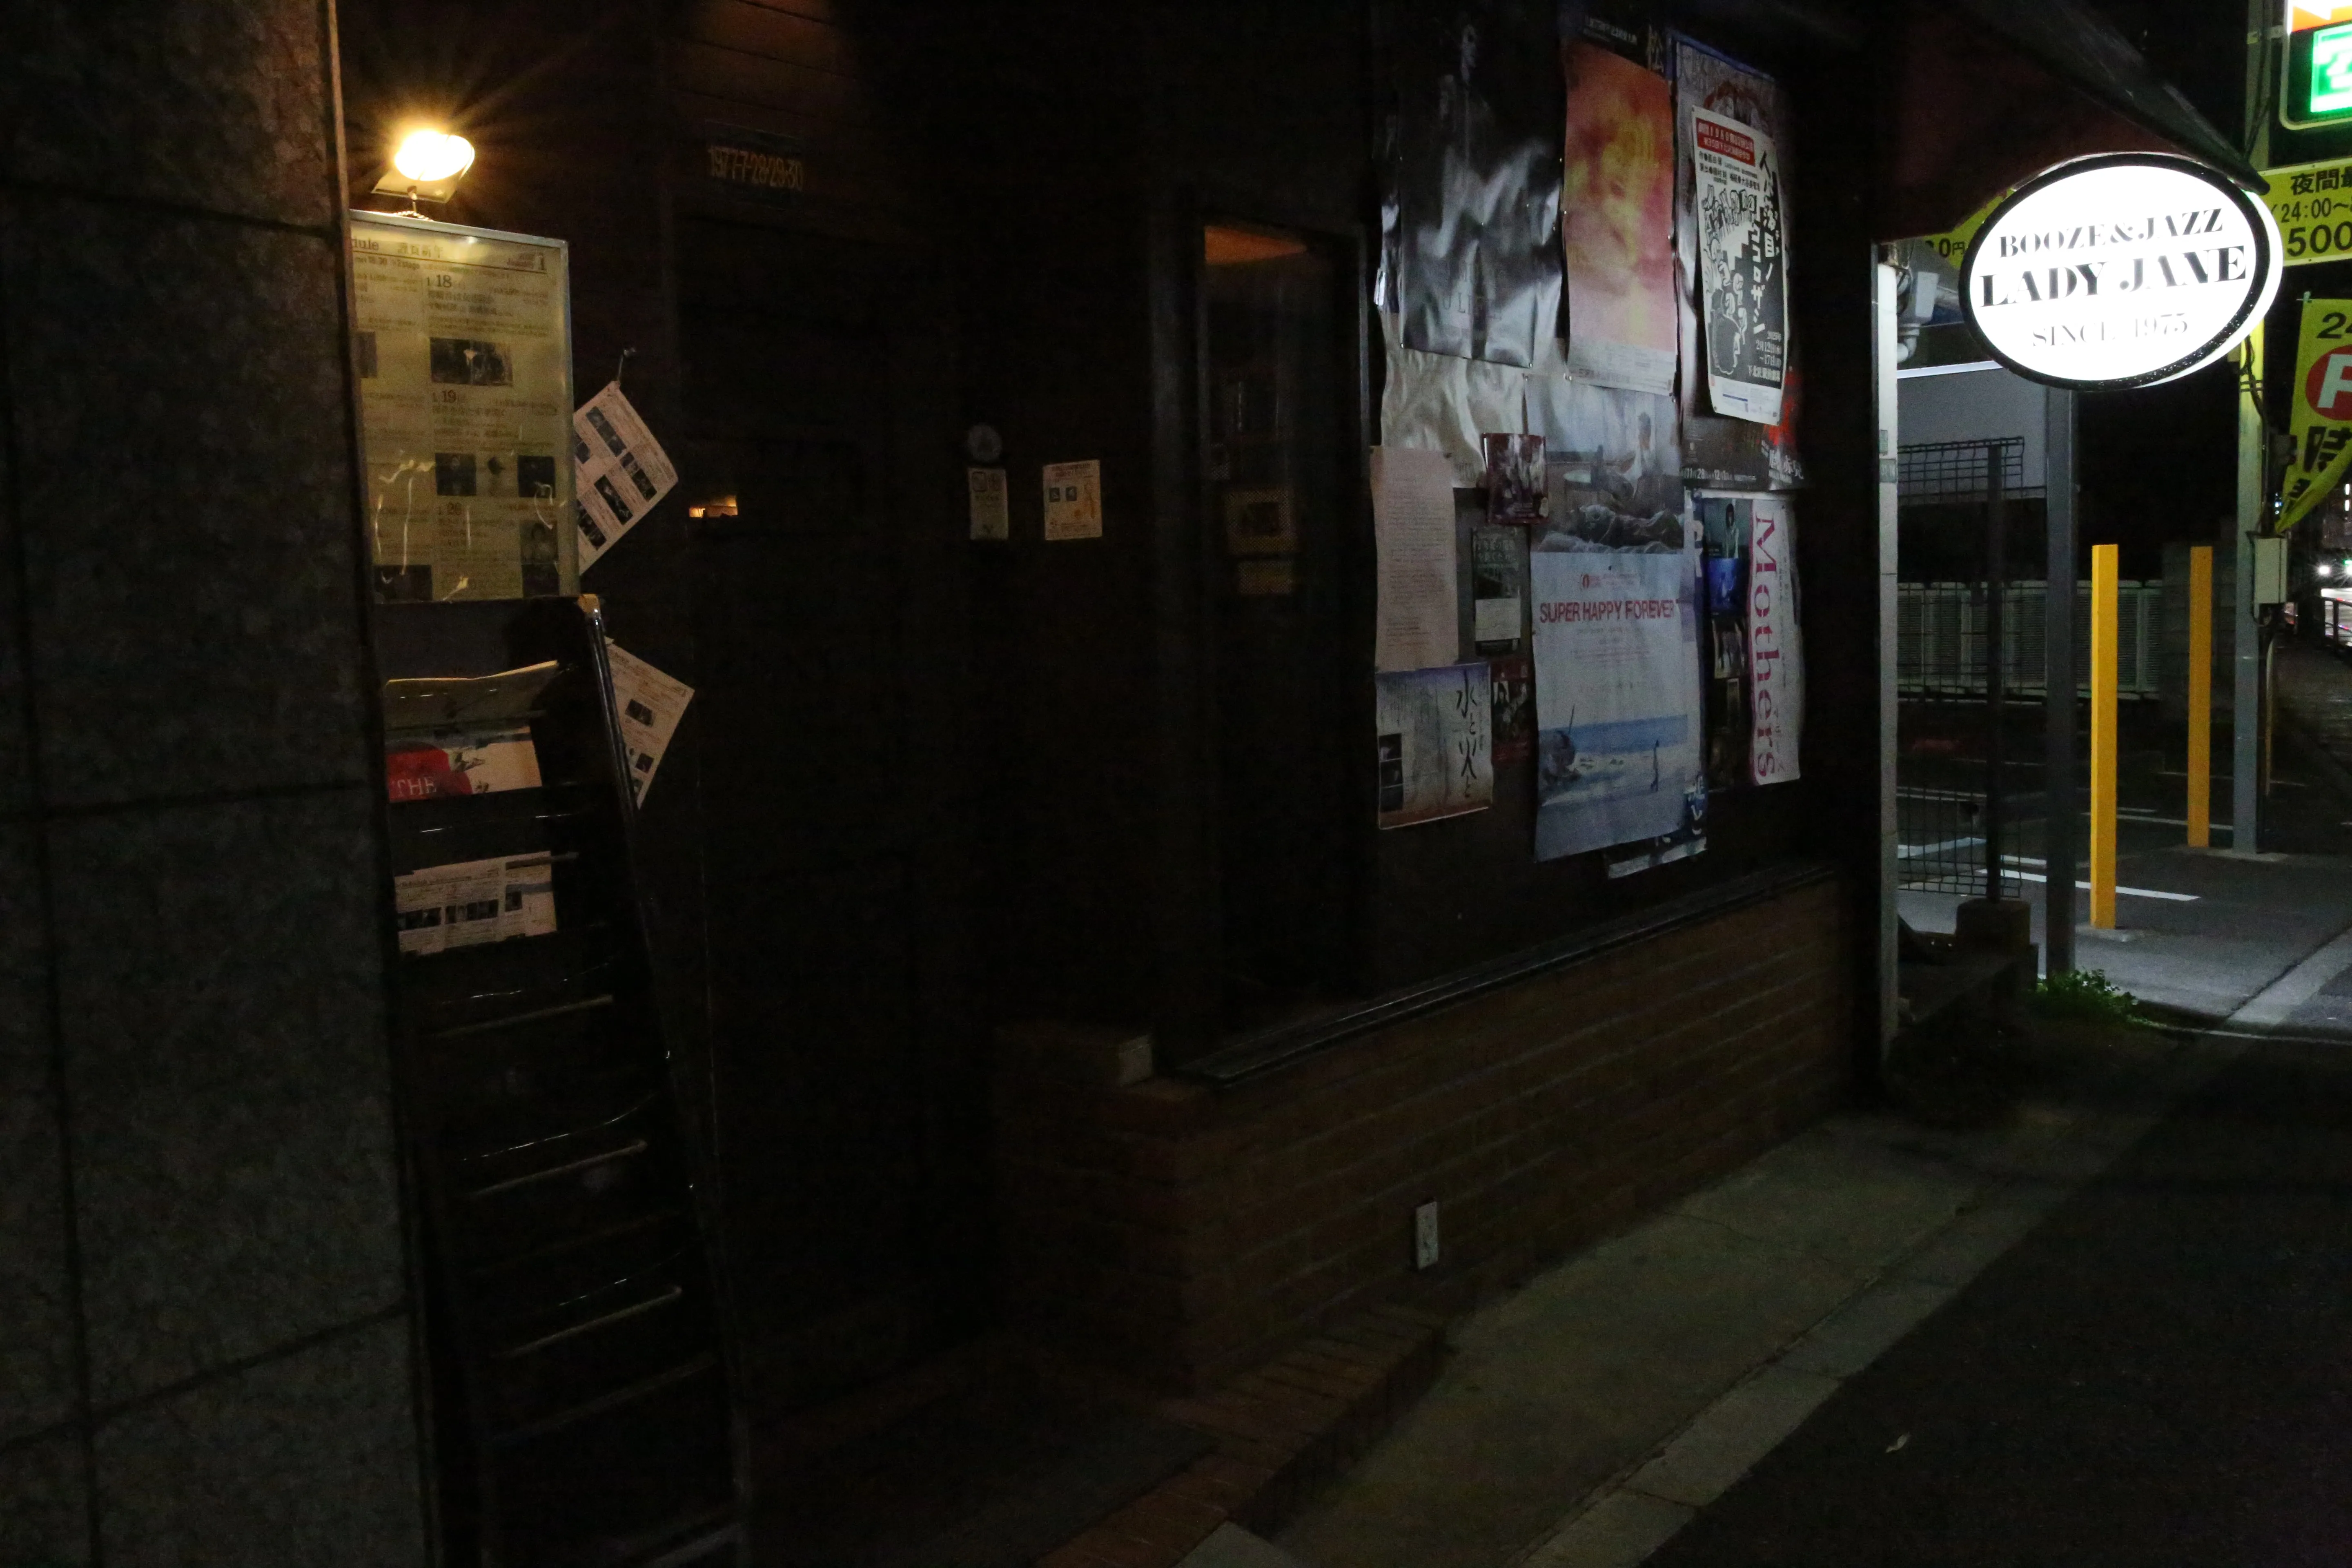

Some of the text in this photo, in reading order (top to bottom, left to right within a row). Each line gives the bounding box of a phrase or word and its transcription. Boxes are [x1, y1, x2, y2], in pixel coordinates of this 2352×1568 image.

[1999, 208, 2223, 258] BOOZE&JAZZ
[436, 274, 452, 287] 18
[1980, 245, 2247, 307] LADY JANE
[2033, 313, 2188, 347] SINCE 1975
[1540, 602, 1581, 624] SUPER
[1583, 601, 1622, 621] HAPPY
[1755, 512, 1780, 777] Mothers
